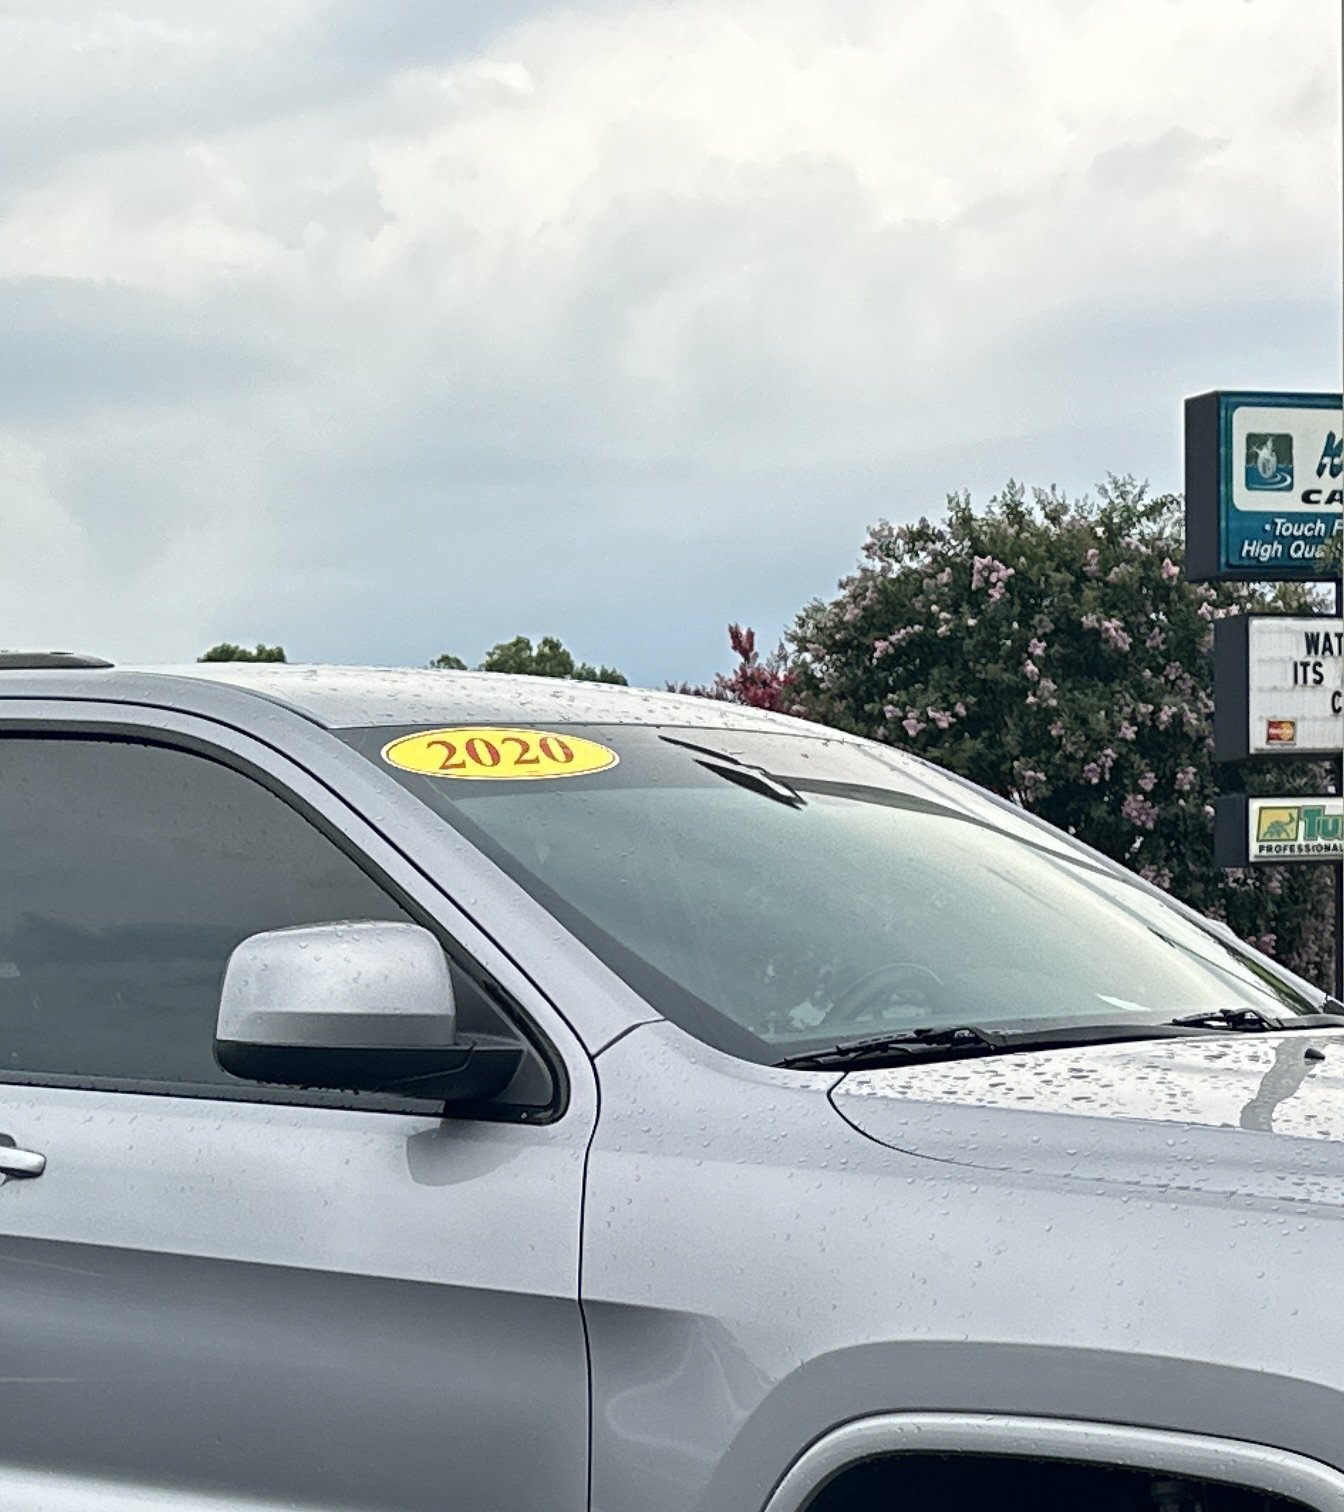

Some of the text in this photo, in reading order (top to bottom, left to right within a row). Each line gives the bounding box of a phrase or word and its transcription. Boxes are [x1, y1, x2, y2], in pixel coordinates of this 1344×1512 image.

[1301, 488, 1344, 506] CA
[1274, 518, 1326, 537] Touch
[1241, 539, 1283, 562] High
[1293, 661, 1324, 685] ITS
[428, 737, 574, 769] 2020
